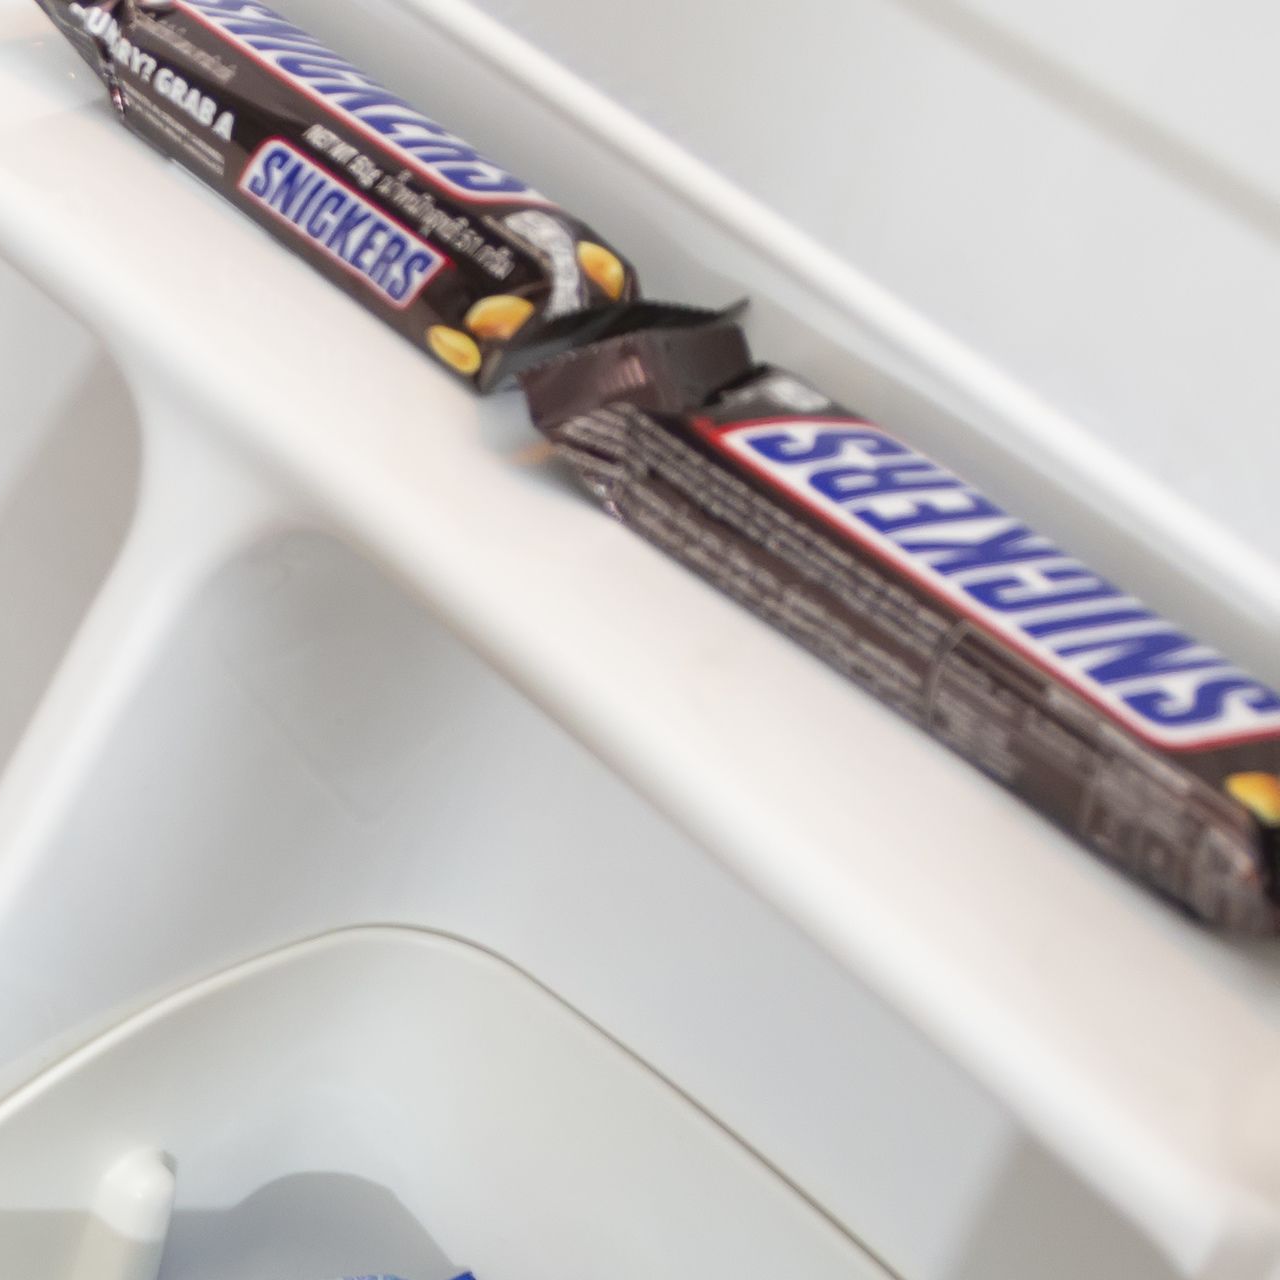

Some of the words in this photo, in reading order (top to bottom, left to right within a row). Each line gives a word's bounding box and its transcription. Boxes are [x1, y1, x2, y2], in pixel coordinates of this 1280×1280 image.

[153, 68, 217, 126] GRAB
[212, 111, 234, 142] A
[248, 148, 433, 300] SNICKERS
[744, 428, 1280, 728] SNICKERS
